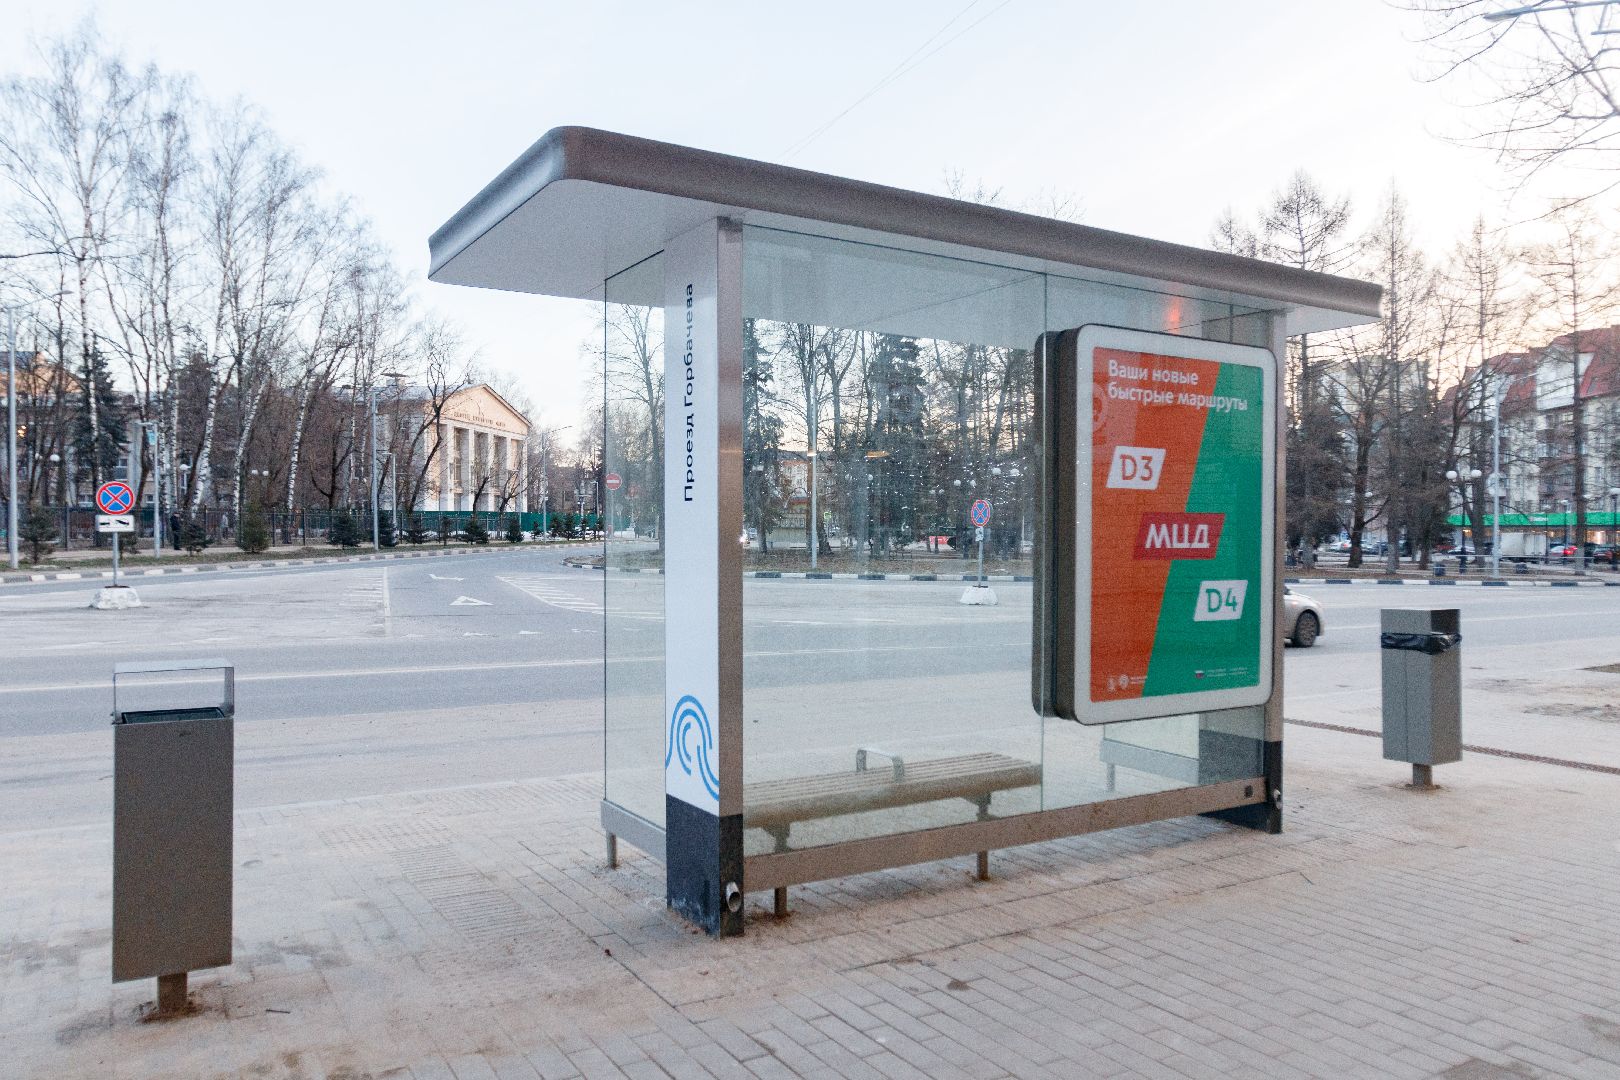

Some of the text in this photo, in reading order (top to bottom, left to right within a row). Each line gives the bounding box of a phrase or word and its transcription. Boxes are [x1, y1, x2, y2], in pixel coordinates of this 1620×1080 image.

[1108, 359, 1199, 386] Ваши новые
[683, 283, 695, 502] Проезд Горбачева
[1107, 381, 1248, 413] быстрые маршруты
[1120, 453, 1154, 482] D3
[1145, 523, 1210, 549] МЦД
[1205, 587, 1238, 613] D4
